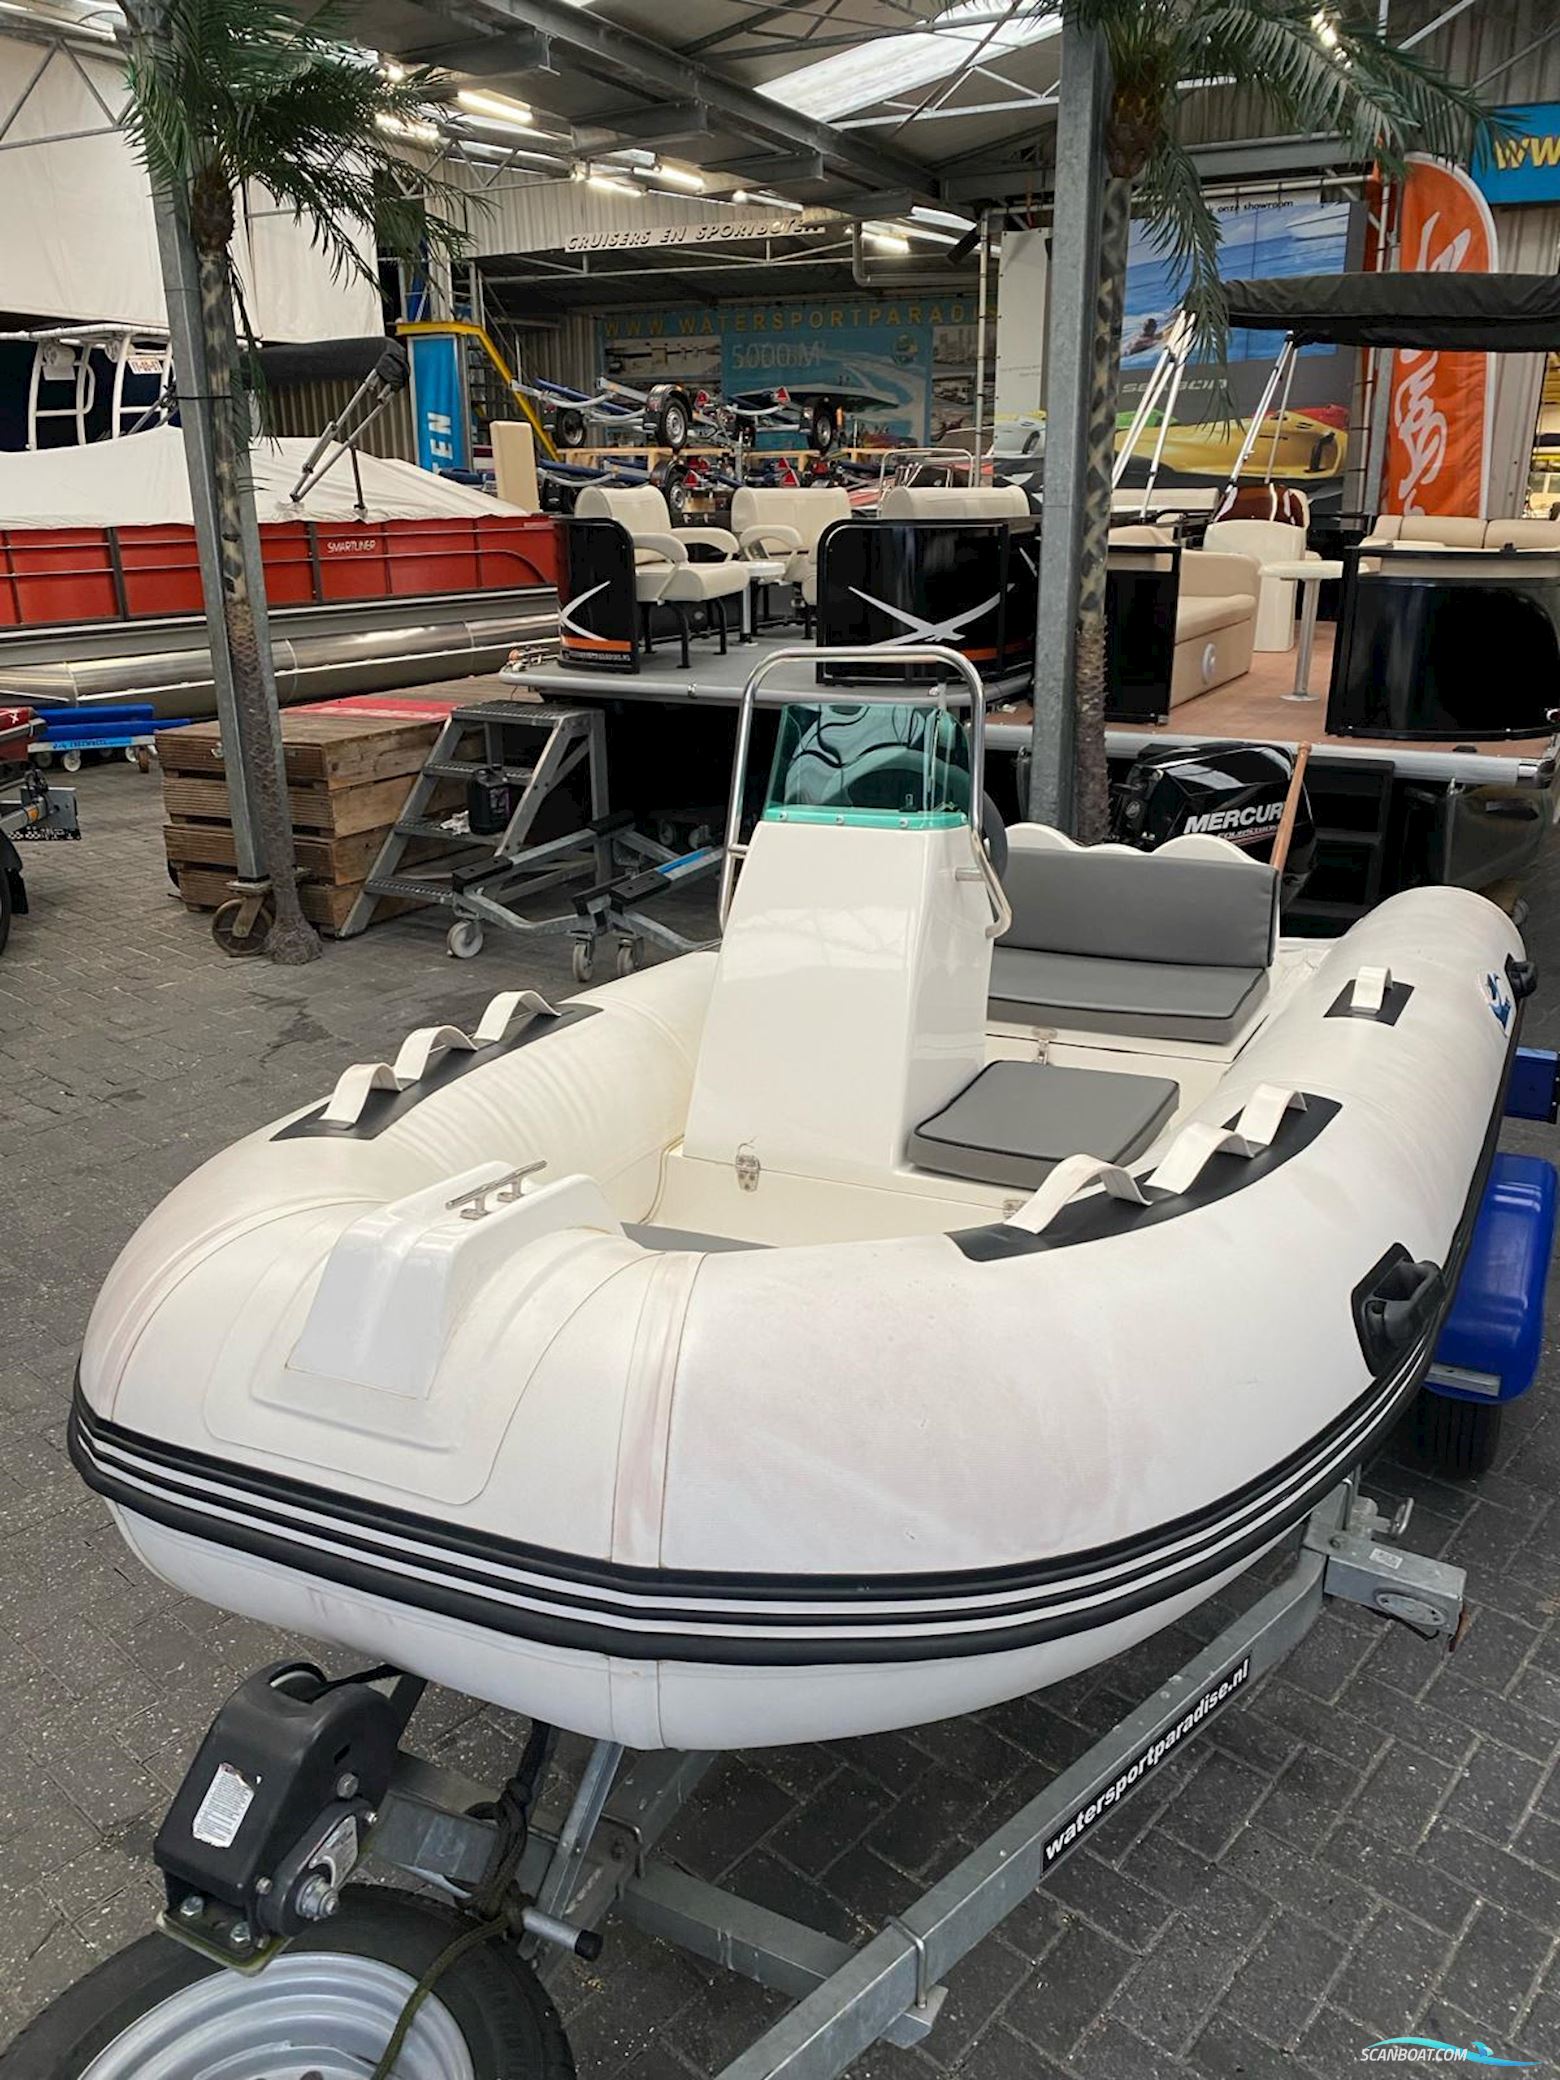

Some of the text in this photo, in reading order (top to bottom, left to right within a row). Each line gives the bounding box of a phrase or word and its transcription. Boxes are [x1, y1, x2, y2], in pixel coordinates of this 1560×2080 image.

[567, 217, 825, 250] CRUISERS EN SPORTBOTE
[1183, 801, 1287, 835] MERCUR
[1045, 1658, 1250, 1861] watersportparadise.nl
